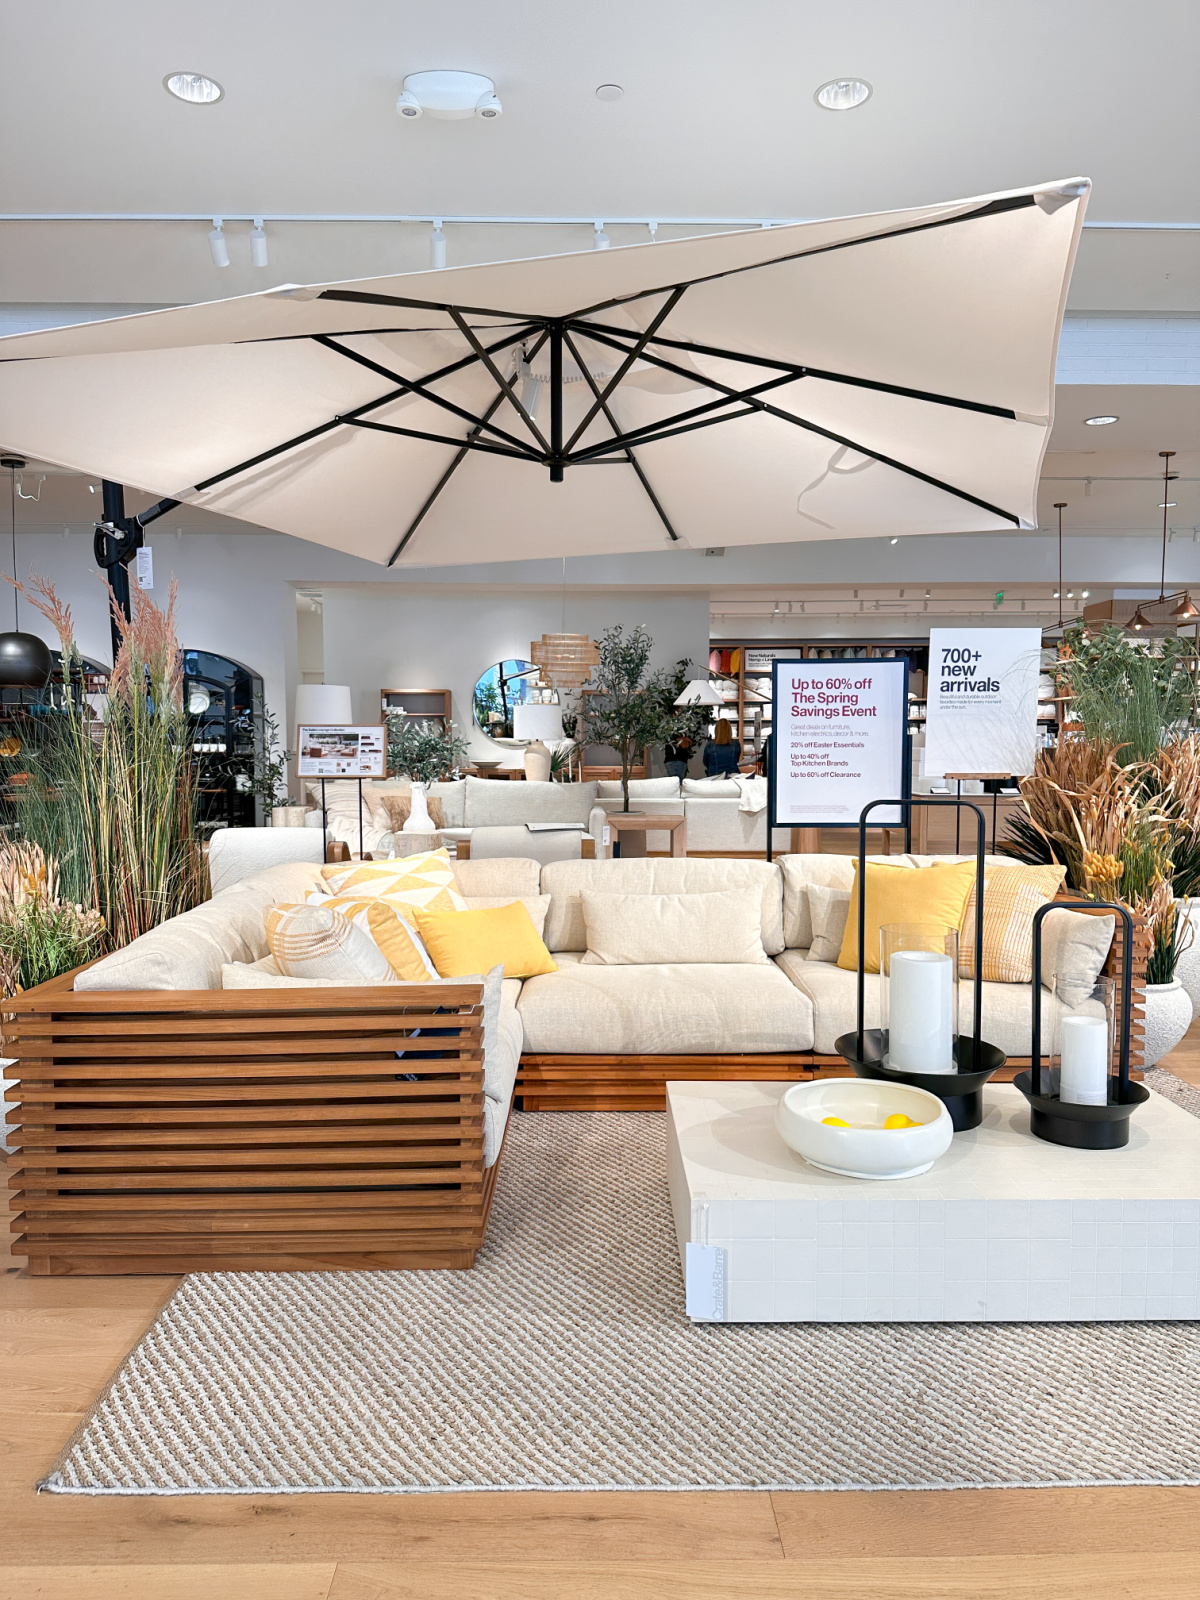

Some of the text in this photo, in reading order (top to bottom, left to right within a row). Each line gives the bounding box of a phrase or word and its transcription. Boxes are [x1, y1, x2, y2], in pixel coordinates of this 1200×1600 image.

[941, 648, 982, 663] 700+
[941, 665, 977, 676] new
[791, 678, 873, 692] Up to 60% off
[940, 677, 1000, 692] arrivals
[792, 692, 858, 706] The Spring
[791, 705, 877, 719] Savings Event
